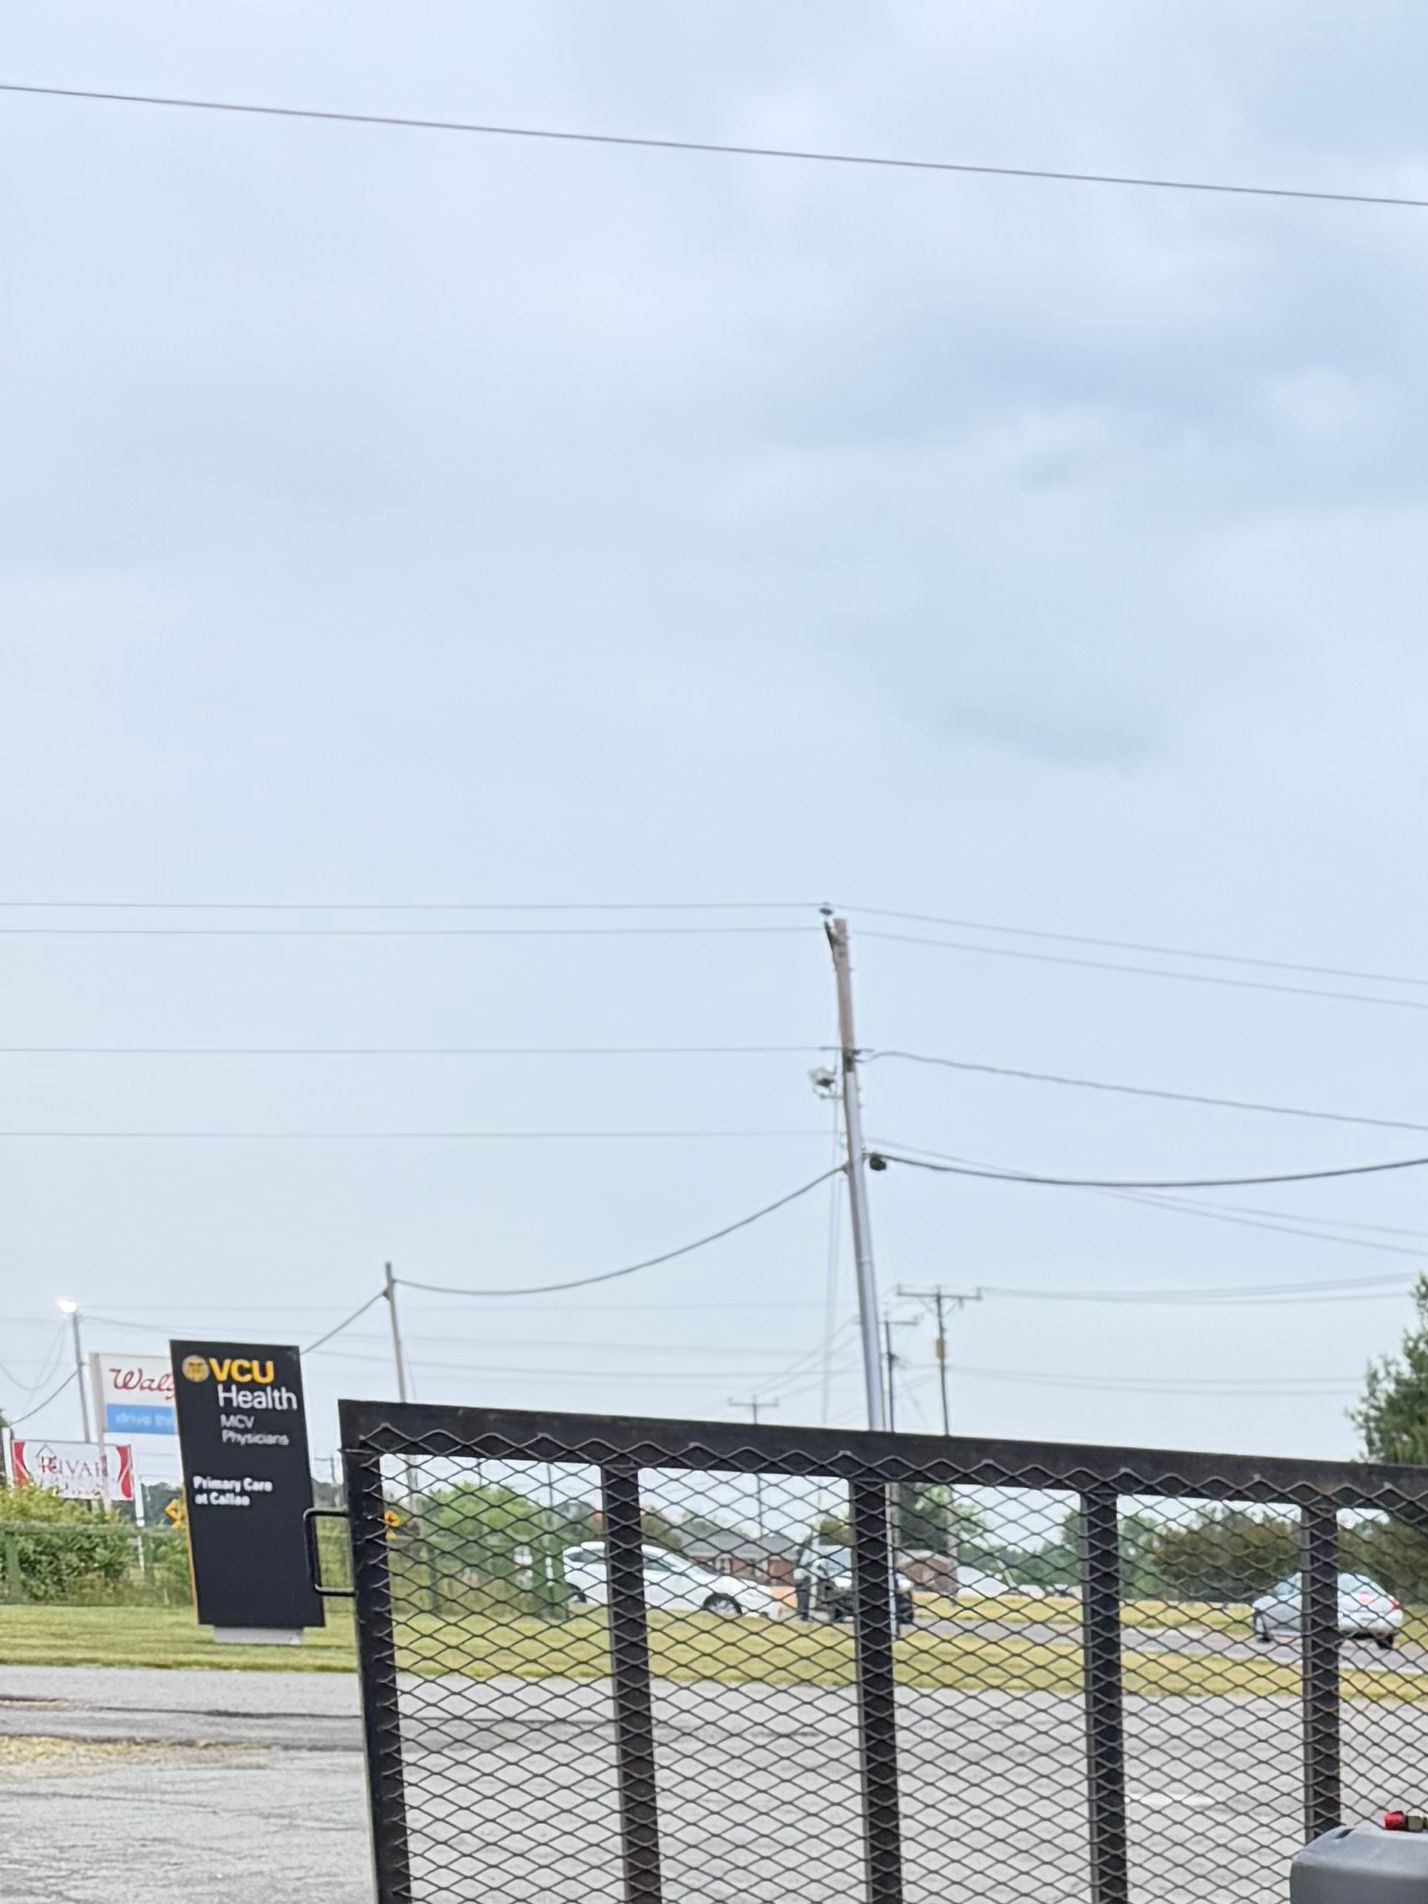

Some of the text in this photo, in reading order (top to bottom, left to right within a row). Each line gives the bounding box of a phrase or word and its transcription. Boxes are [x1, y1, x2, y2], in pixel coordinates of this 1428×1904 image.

[209, 1357, 275, 1384] VCU
[217, 1384, 298, 1410] Health
[220, 1414, 255, 1429] MCV
[221, 1429, 290, 1446] Physicians
[192, 1475, 273, 1493] Primary Care
[194, 1493, 208, 1505] at
